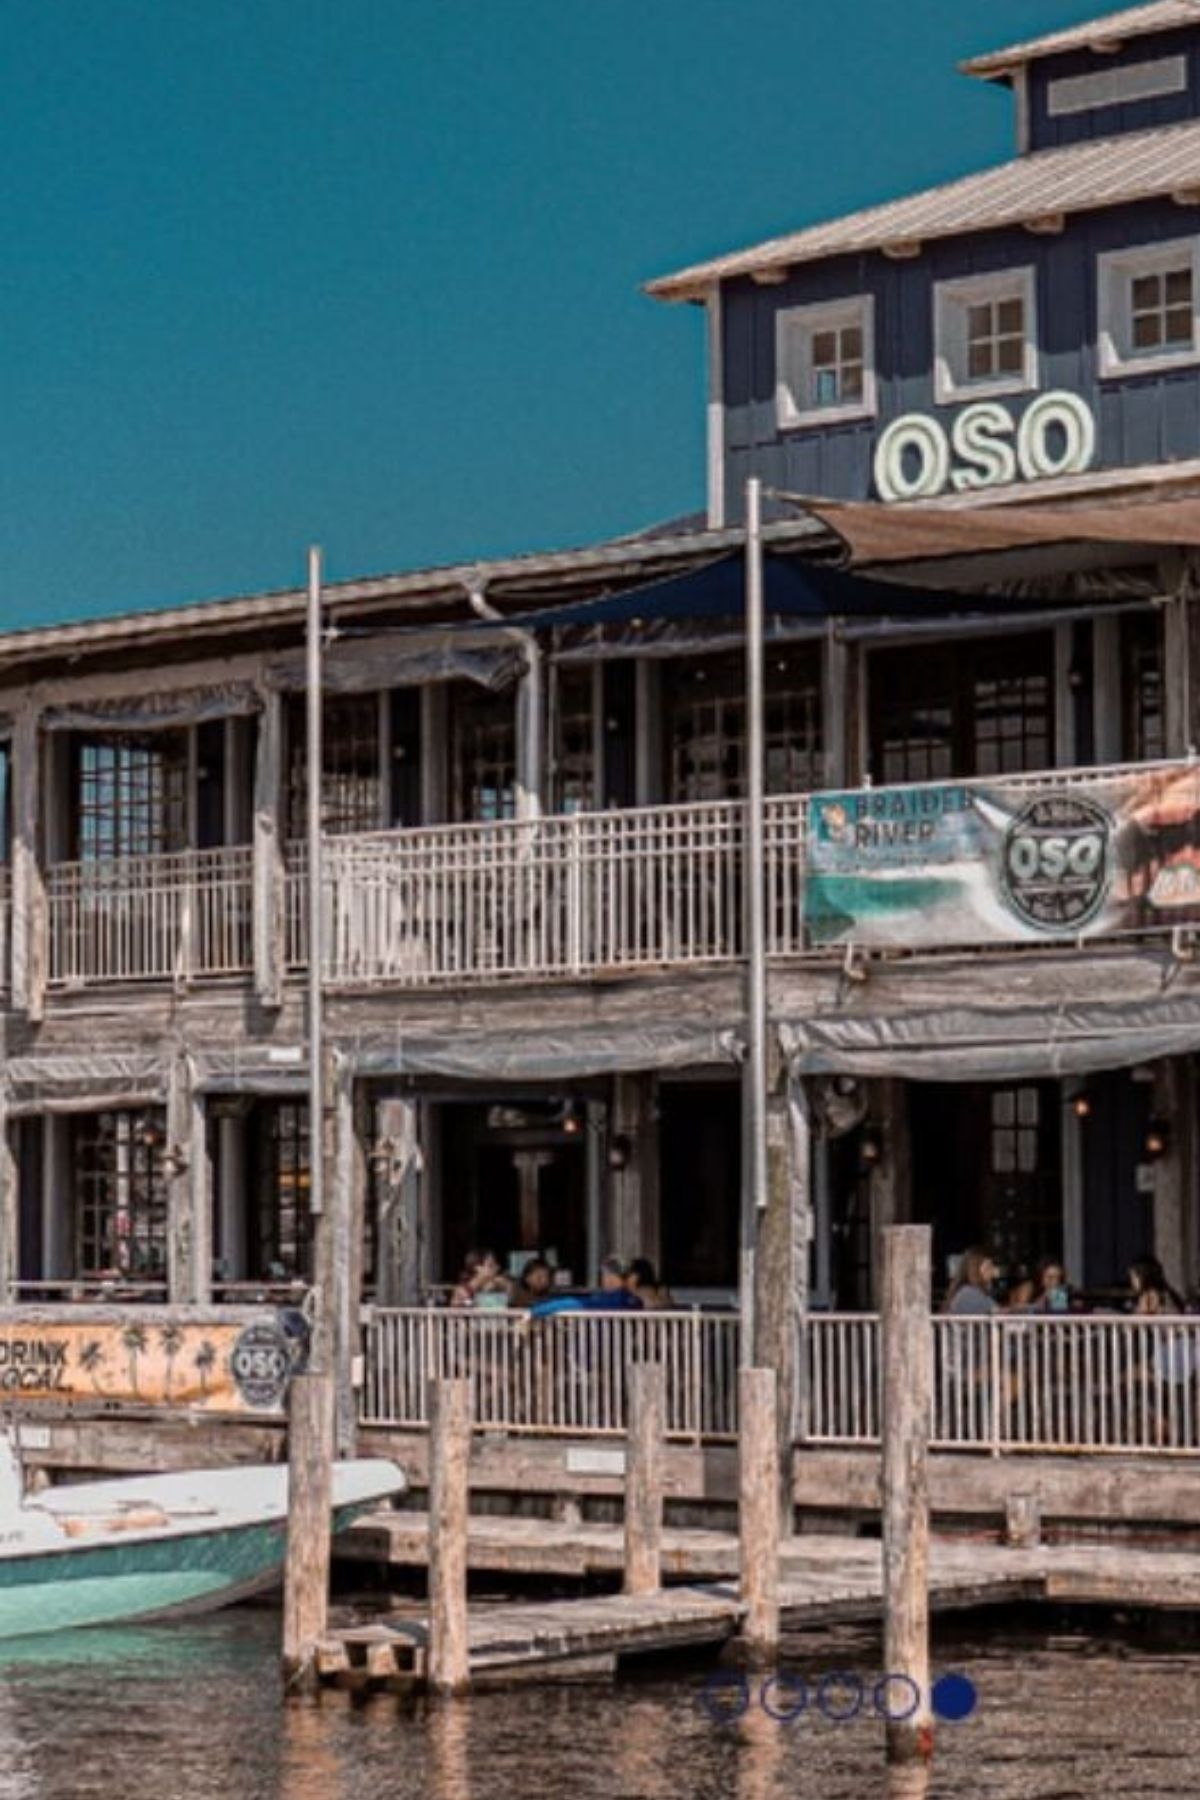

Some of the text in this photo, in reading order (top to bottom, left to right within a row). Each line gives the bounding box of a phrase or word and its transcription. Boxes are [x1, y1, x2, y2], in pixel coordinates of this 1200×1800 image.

[874, 390, 1095, 503] OSO
[856, 819, 935, 846] RIVER
[1009, 834, 1102, 880] OSO
